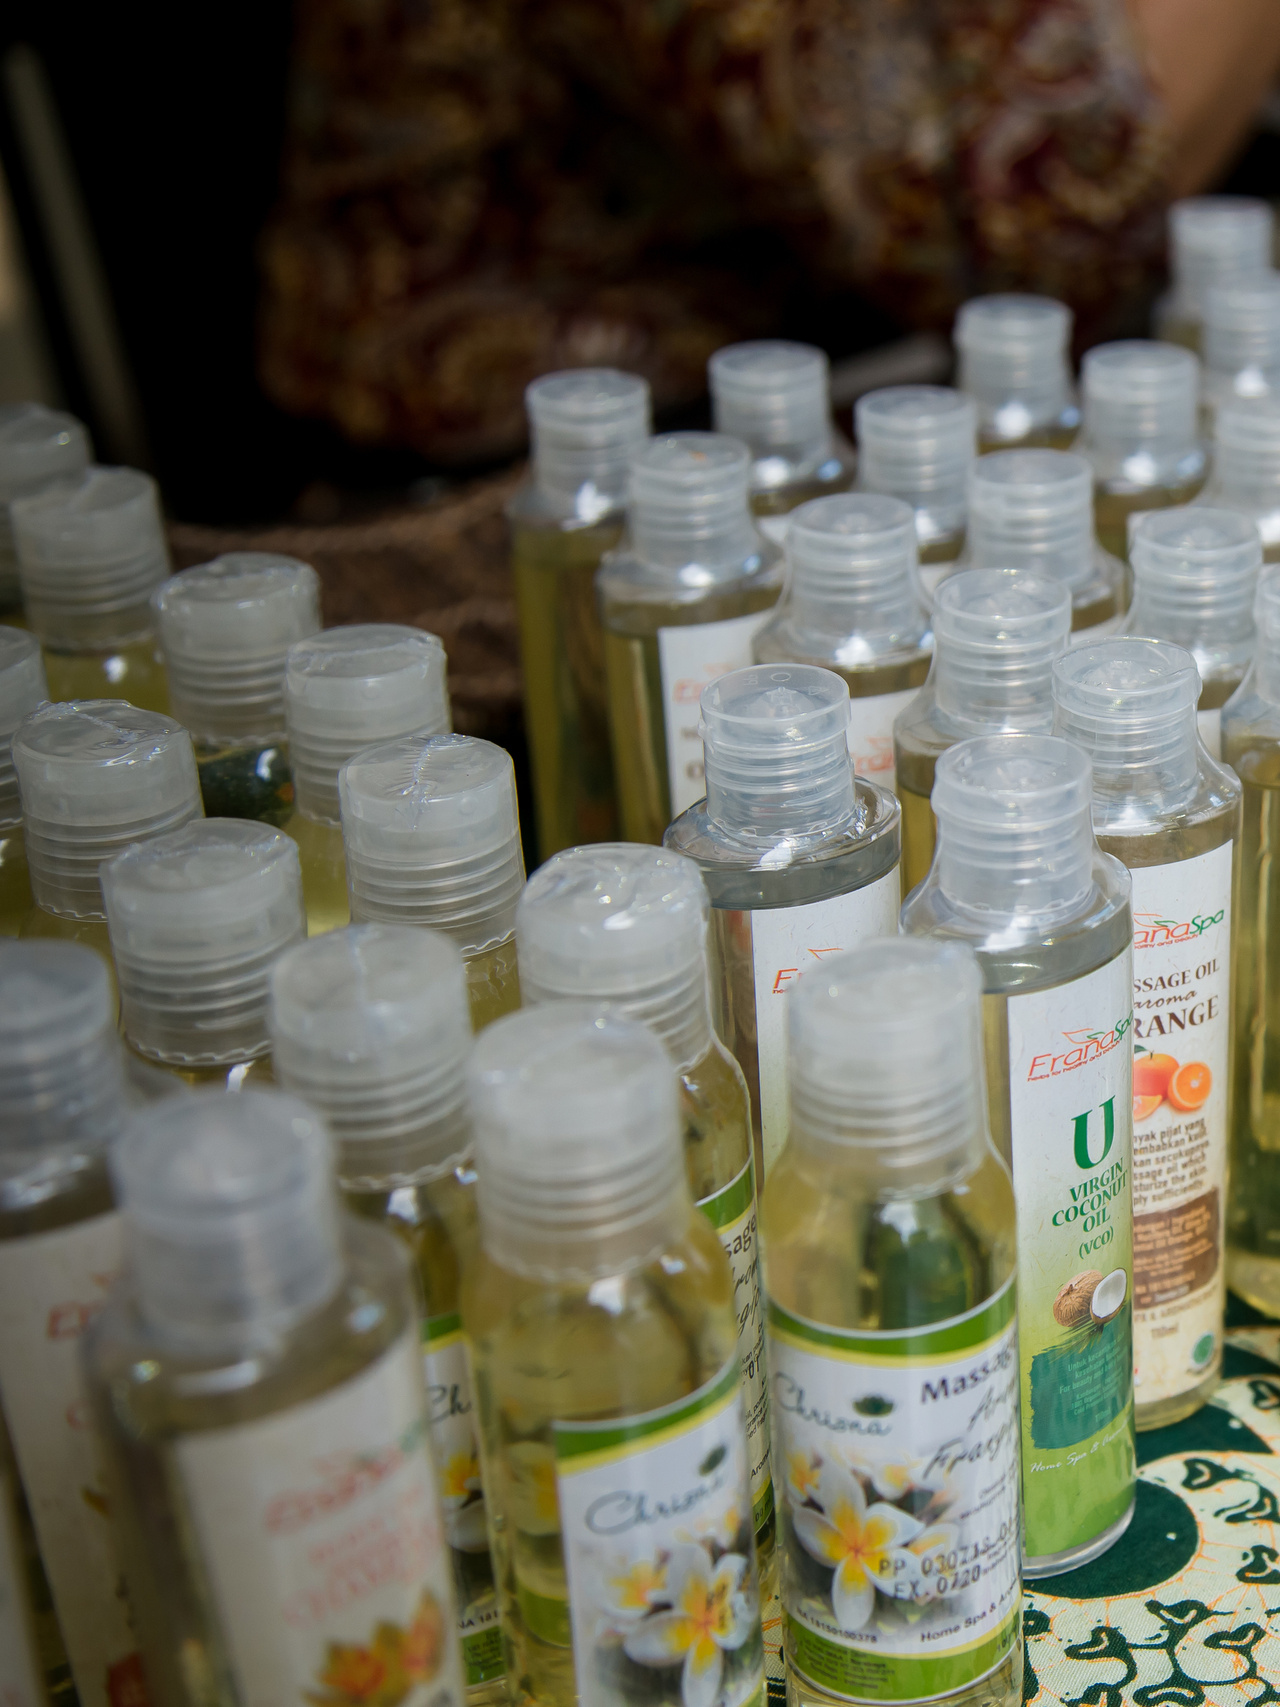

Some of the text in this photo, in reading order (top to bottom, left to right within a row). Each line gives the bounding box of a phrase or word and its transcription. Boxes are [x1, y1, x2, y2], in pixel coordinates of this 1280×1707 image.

[1133, 909, 1225, 945] anaSpa
[1133, 958, 1220, 994] SSAGE OIL
[1133, 995, 1220, 1040] RANGE
[1070, 1094, 1116, 1170] U
[1051, 1169, 1128, 1227] COCONUT
[1069, 1156, 1124, 1203] VIRGIN
[724, 1213, 757, 1259] sage
[1082, 1206, 1112, 1234] OIL
[1078, 1225, 1114, 1260] (VCO)
[920, 1624, 960, 1643] Home
[964, 1610, 987, 1629] Spa
